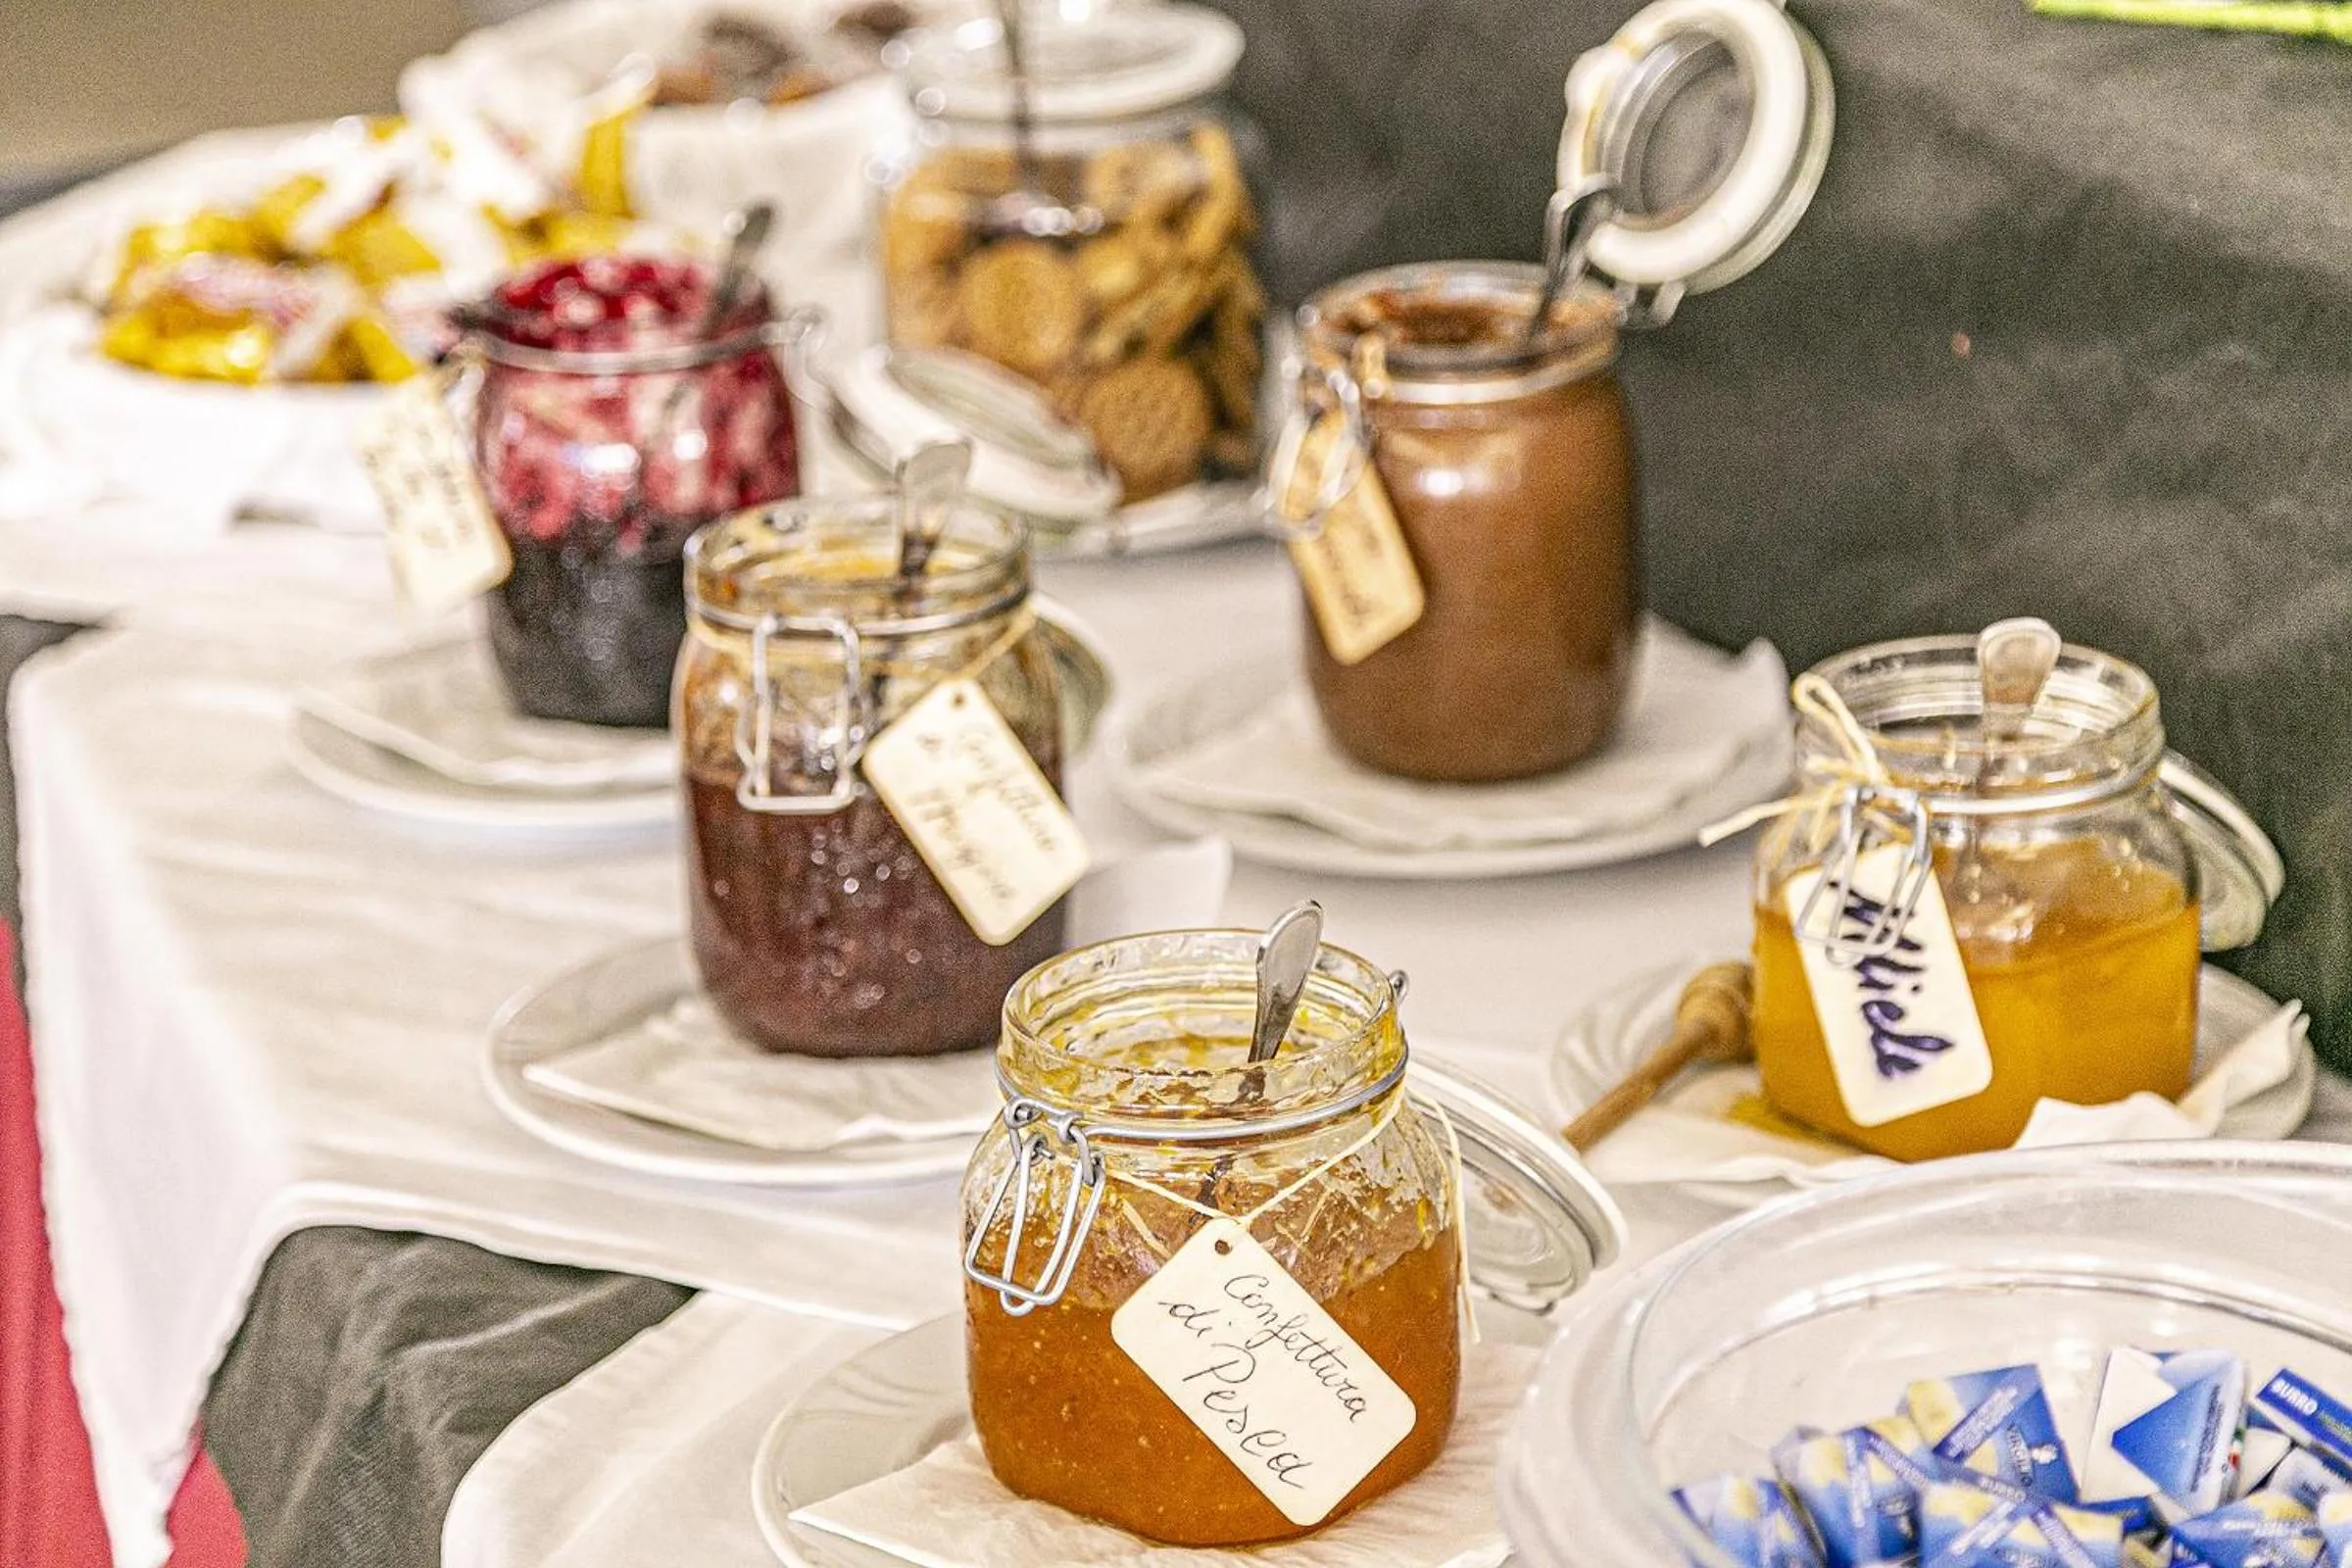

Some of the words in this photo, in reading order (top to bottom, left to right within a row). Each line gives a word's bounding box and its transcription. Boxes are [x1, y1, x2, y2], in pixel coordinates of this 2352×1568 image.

[1157, 1301, 1232, 1338] di
[1224, 1274, 1366, 1423] Confettura
[1182, 1343, 1313, 1490] Pesca
[2271, 1378, 2319, 1415] BURRO
